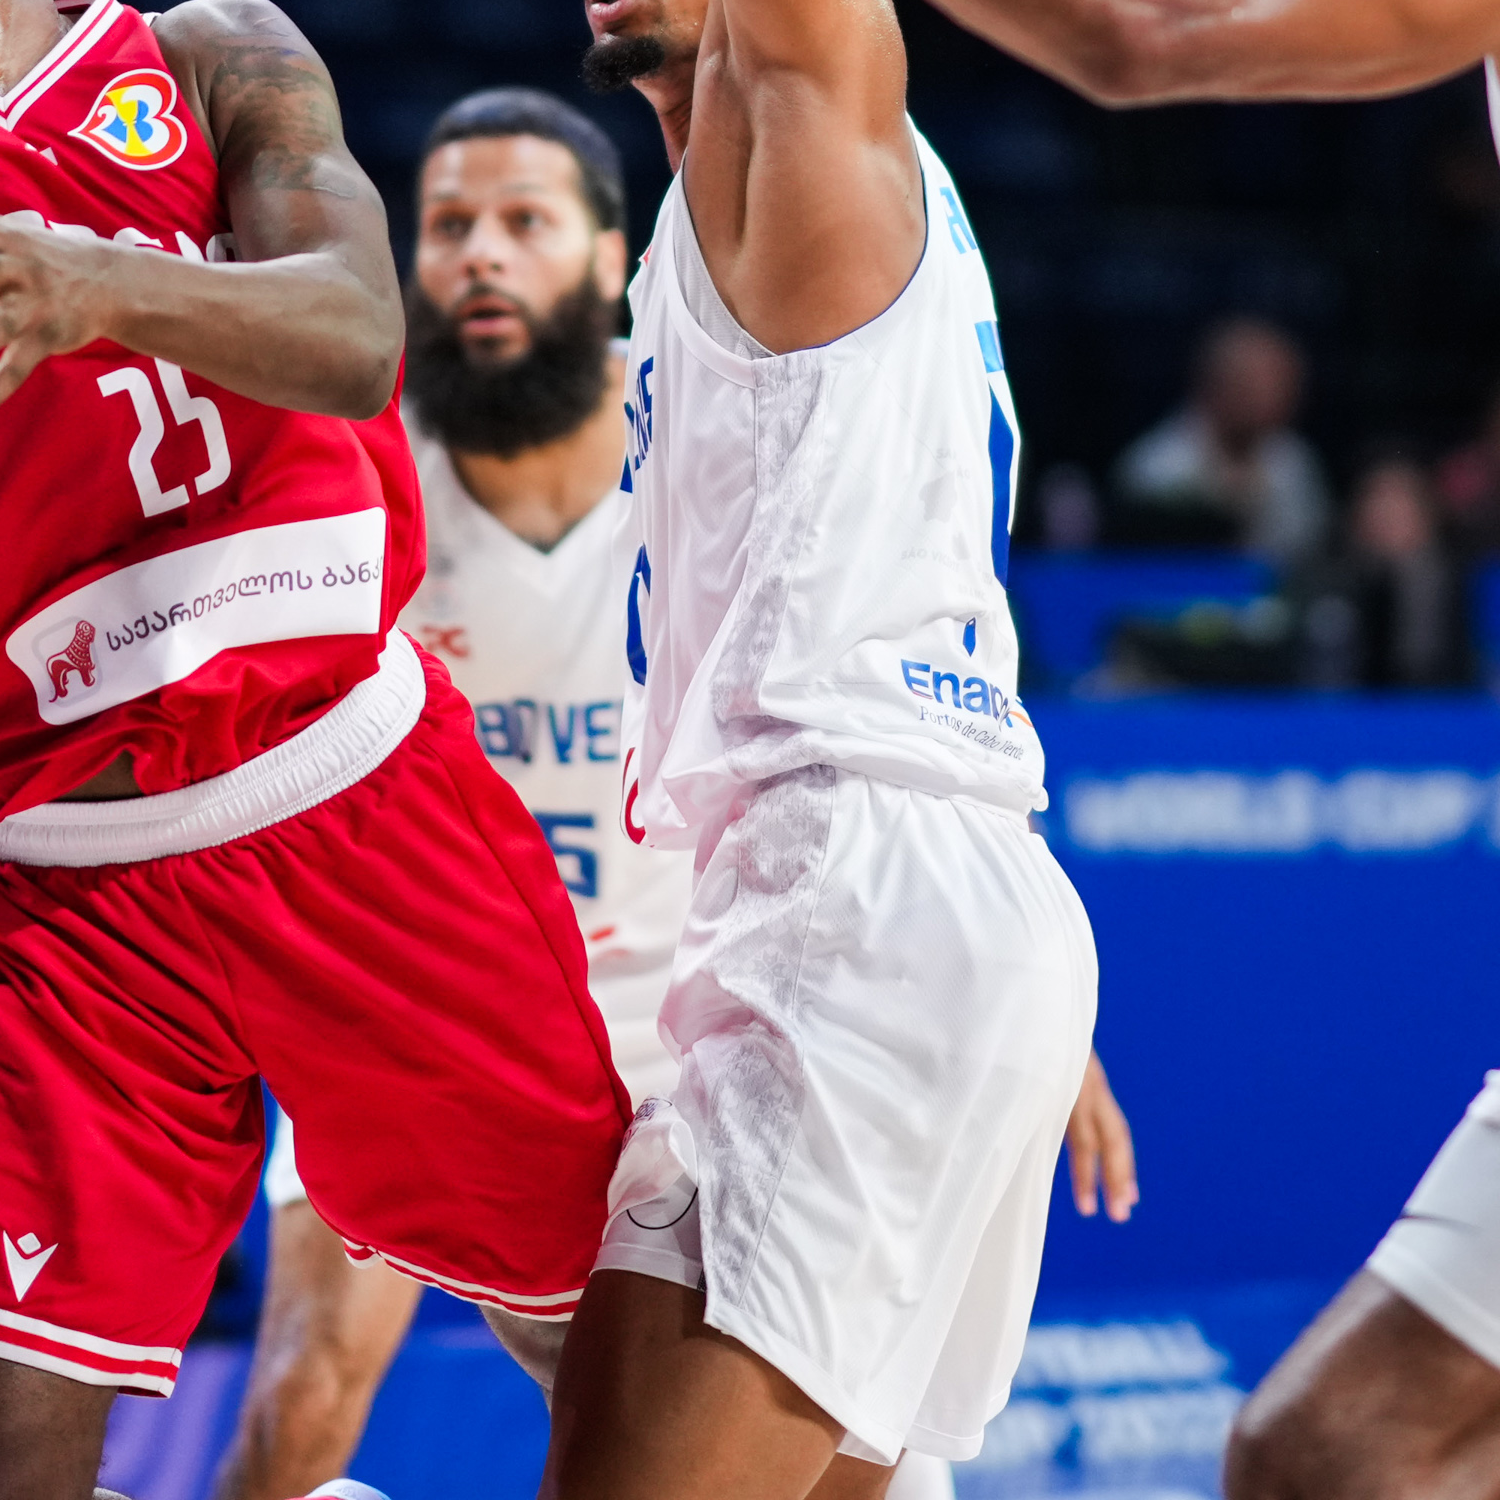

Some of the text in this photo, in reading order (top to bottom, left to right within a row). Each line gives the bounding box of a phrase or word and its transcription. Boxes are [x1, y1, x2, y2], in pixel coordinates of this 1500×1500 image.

[96, 356, 232, 518] 25
[106, 570, 313, 651] საქართველოს
[919, 705, 963, 732] Portos
[962, 722, 977, 739] de
[973, 730, 1001, 749] Cabo
